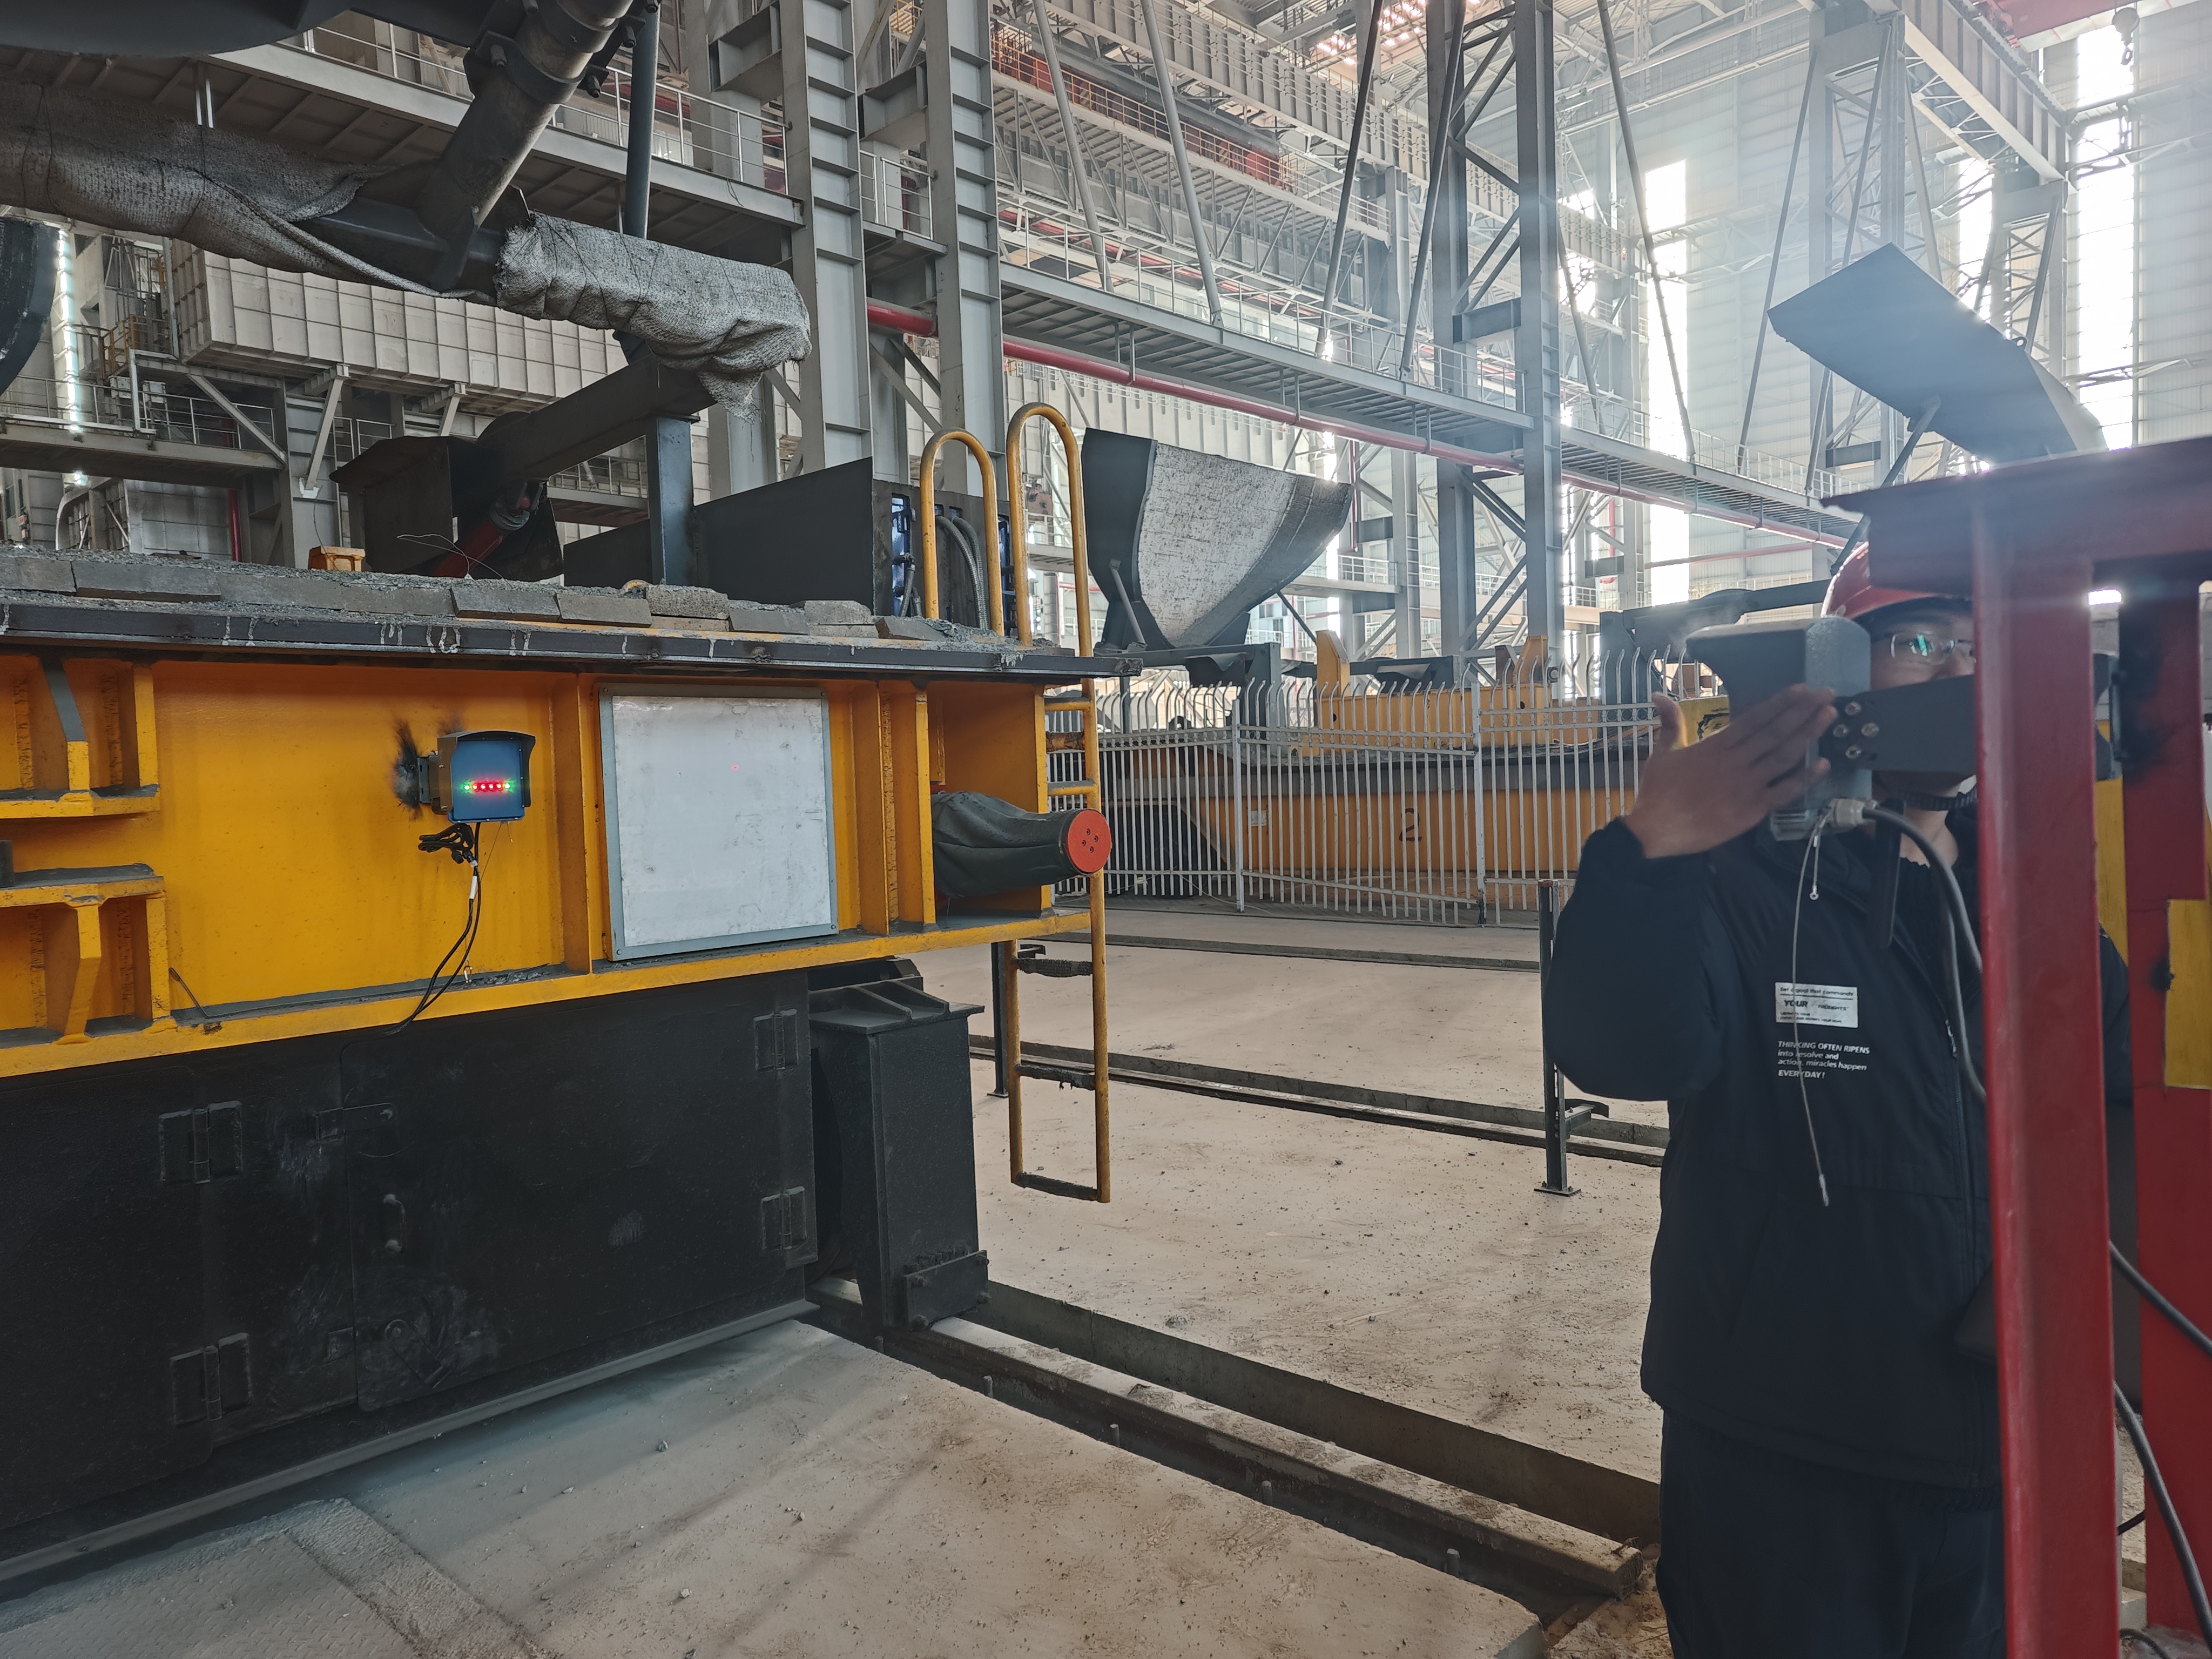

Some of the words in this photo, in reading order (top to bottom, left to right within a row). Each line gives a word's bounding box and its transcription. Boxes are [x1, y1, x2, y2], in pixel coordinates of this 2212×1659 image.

[1399, 808, 1422, 841] 2
[1784, 999, 1808, 1008] YOUR
[1777, 1041, 1816, 1049] THINKING
[1818, 1043, 1843, 1051] OFTEN
[1844, 1045, 1870, 1054] RIPENS
[1777, 1049, 1794, 1057] into
[1806, 1060, 1837, 1068] miracles
[1838, 1061, 1867, 1071] happen
